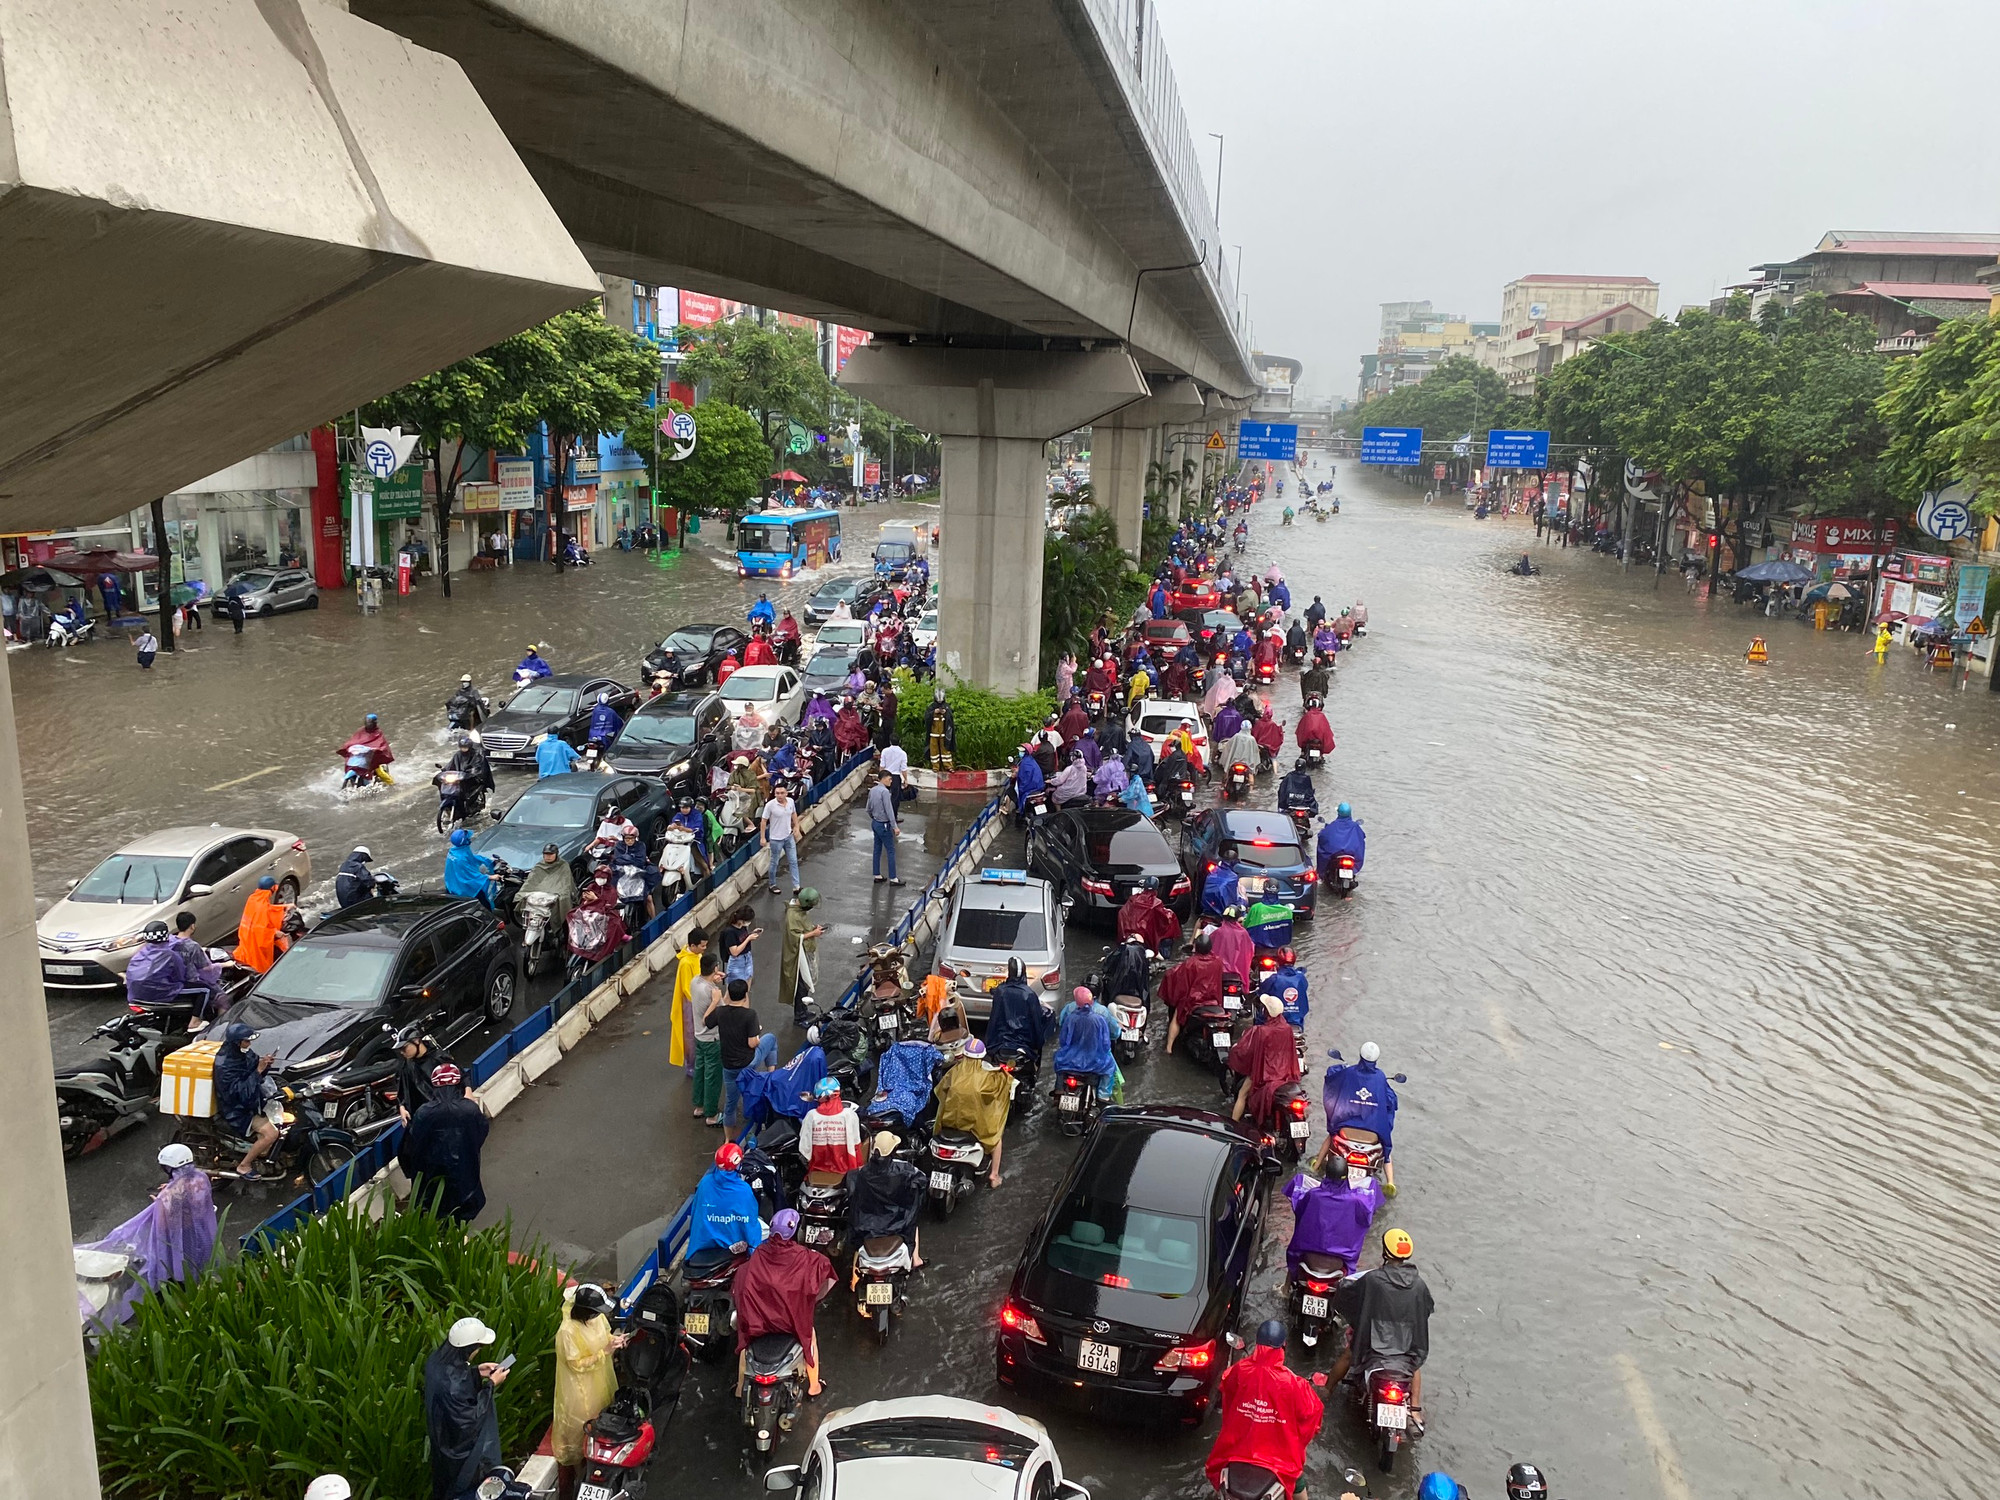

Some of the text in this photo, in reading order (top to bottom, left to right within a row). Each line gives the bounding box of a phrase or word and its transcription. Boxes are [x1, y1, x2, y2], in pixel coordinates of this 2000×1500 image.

[325, 516, 335, 524] 251
[1742, 521, 1761, 531] VENUS
[1797, 522, 1818, 539] MIXUE
[868, 1294, 891, 1303] 480.89
[1303, 1304, 1326, 1317] 250.63
[687, 1315, 706, 1324] 29-E2
[1089, 1343, 1110, 1359] 29A
[1081, 1354, 1117, 1373] 191.48
[1382, 1406, 1402, 1417] 21-E1
[582, 1485, 605, 1500] 29-C1
